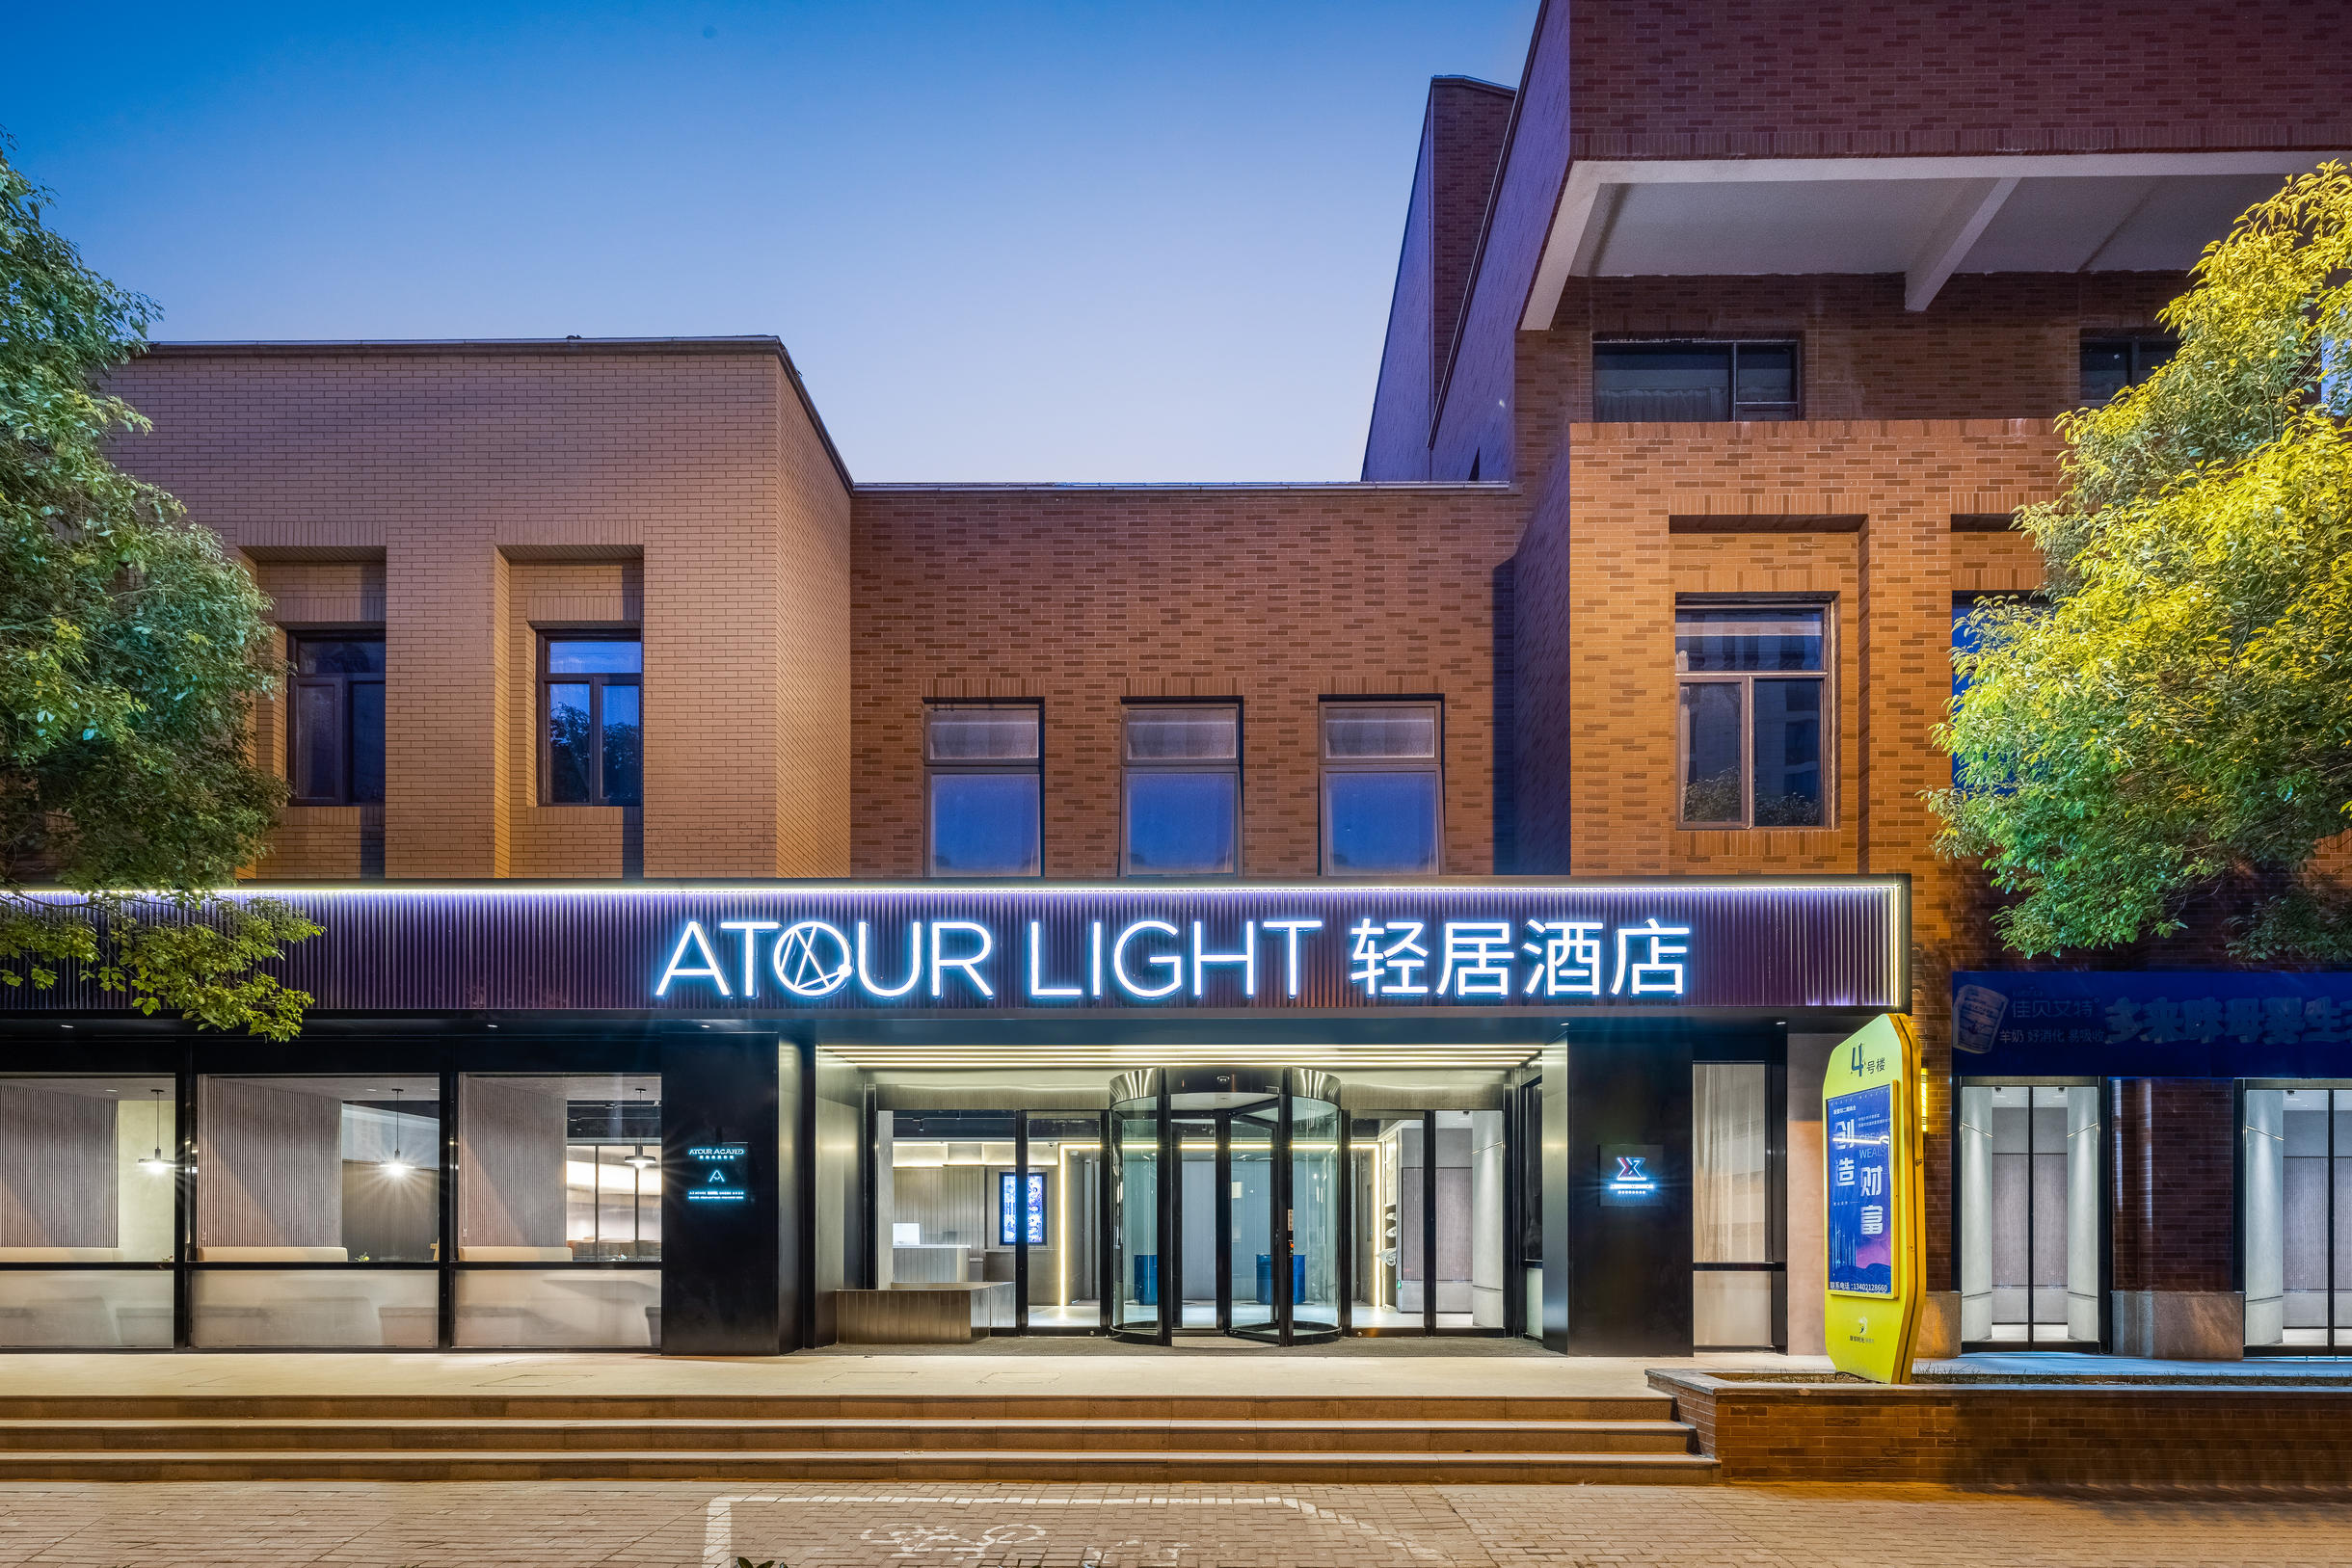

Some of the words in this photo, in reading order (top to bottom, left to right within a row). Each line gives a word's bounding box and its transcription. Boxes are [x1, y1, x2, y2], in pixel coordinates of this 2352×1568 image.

[656, 921, 992, 997] ATOUR
[1030, 920, 1322, 997] LIGHT
[1350, 918, 1690, 996] 轻居酒店
[2012, 999, 2093, 1019] 佳贝艾特
[2105, 997, 2352, 1044] 多来咪母婴生
[1999, 1028, 2024, 1044] 羊奶
